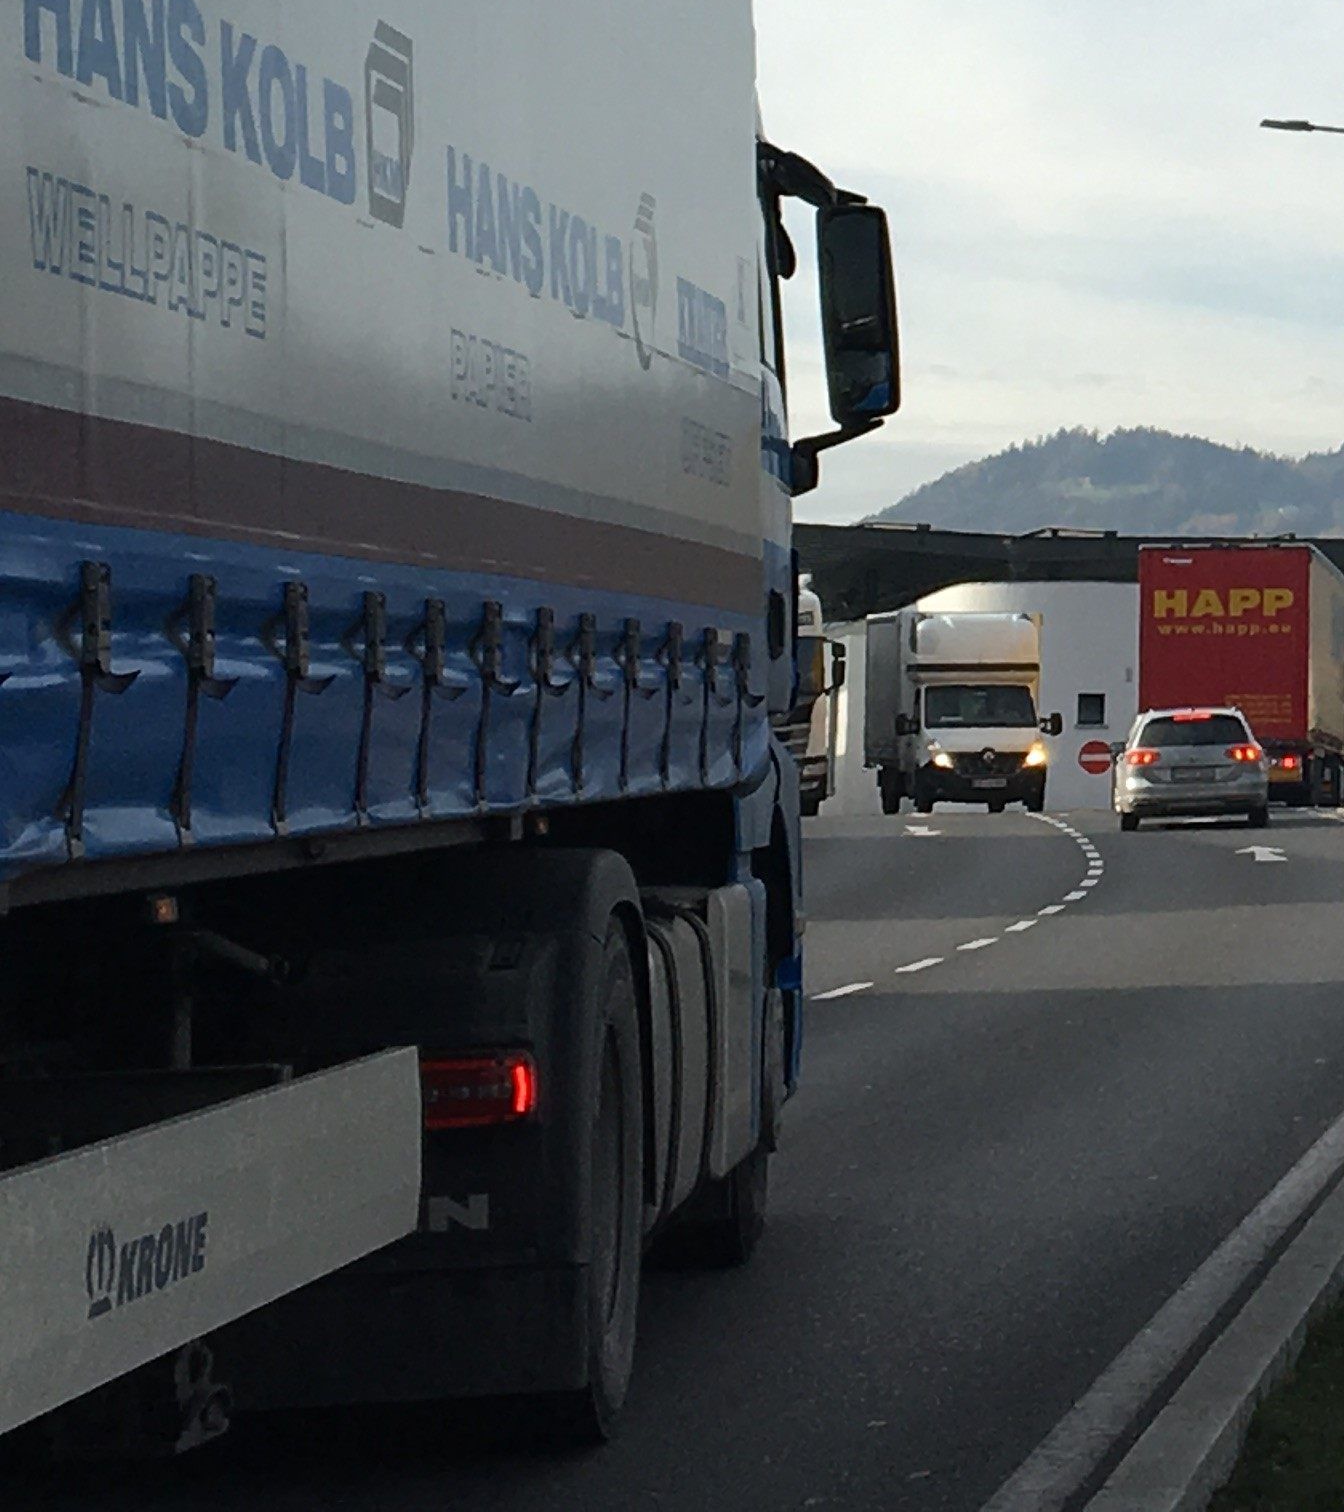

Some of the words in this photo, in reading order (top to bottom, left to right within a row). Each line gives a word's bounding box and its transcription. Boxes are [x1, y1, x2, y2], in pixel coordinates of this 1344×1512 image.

[219, 18, 356, 206] KOLB
[26, 165, 267, 340] WELLPAPPE
[446, 144, 544, 297] HANS
[548, 201, 626, 329] KOLB
[1153, 589, 1294, 618] HAPP
[115, 1211, 208, 1307] KRONE
